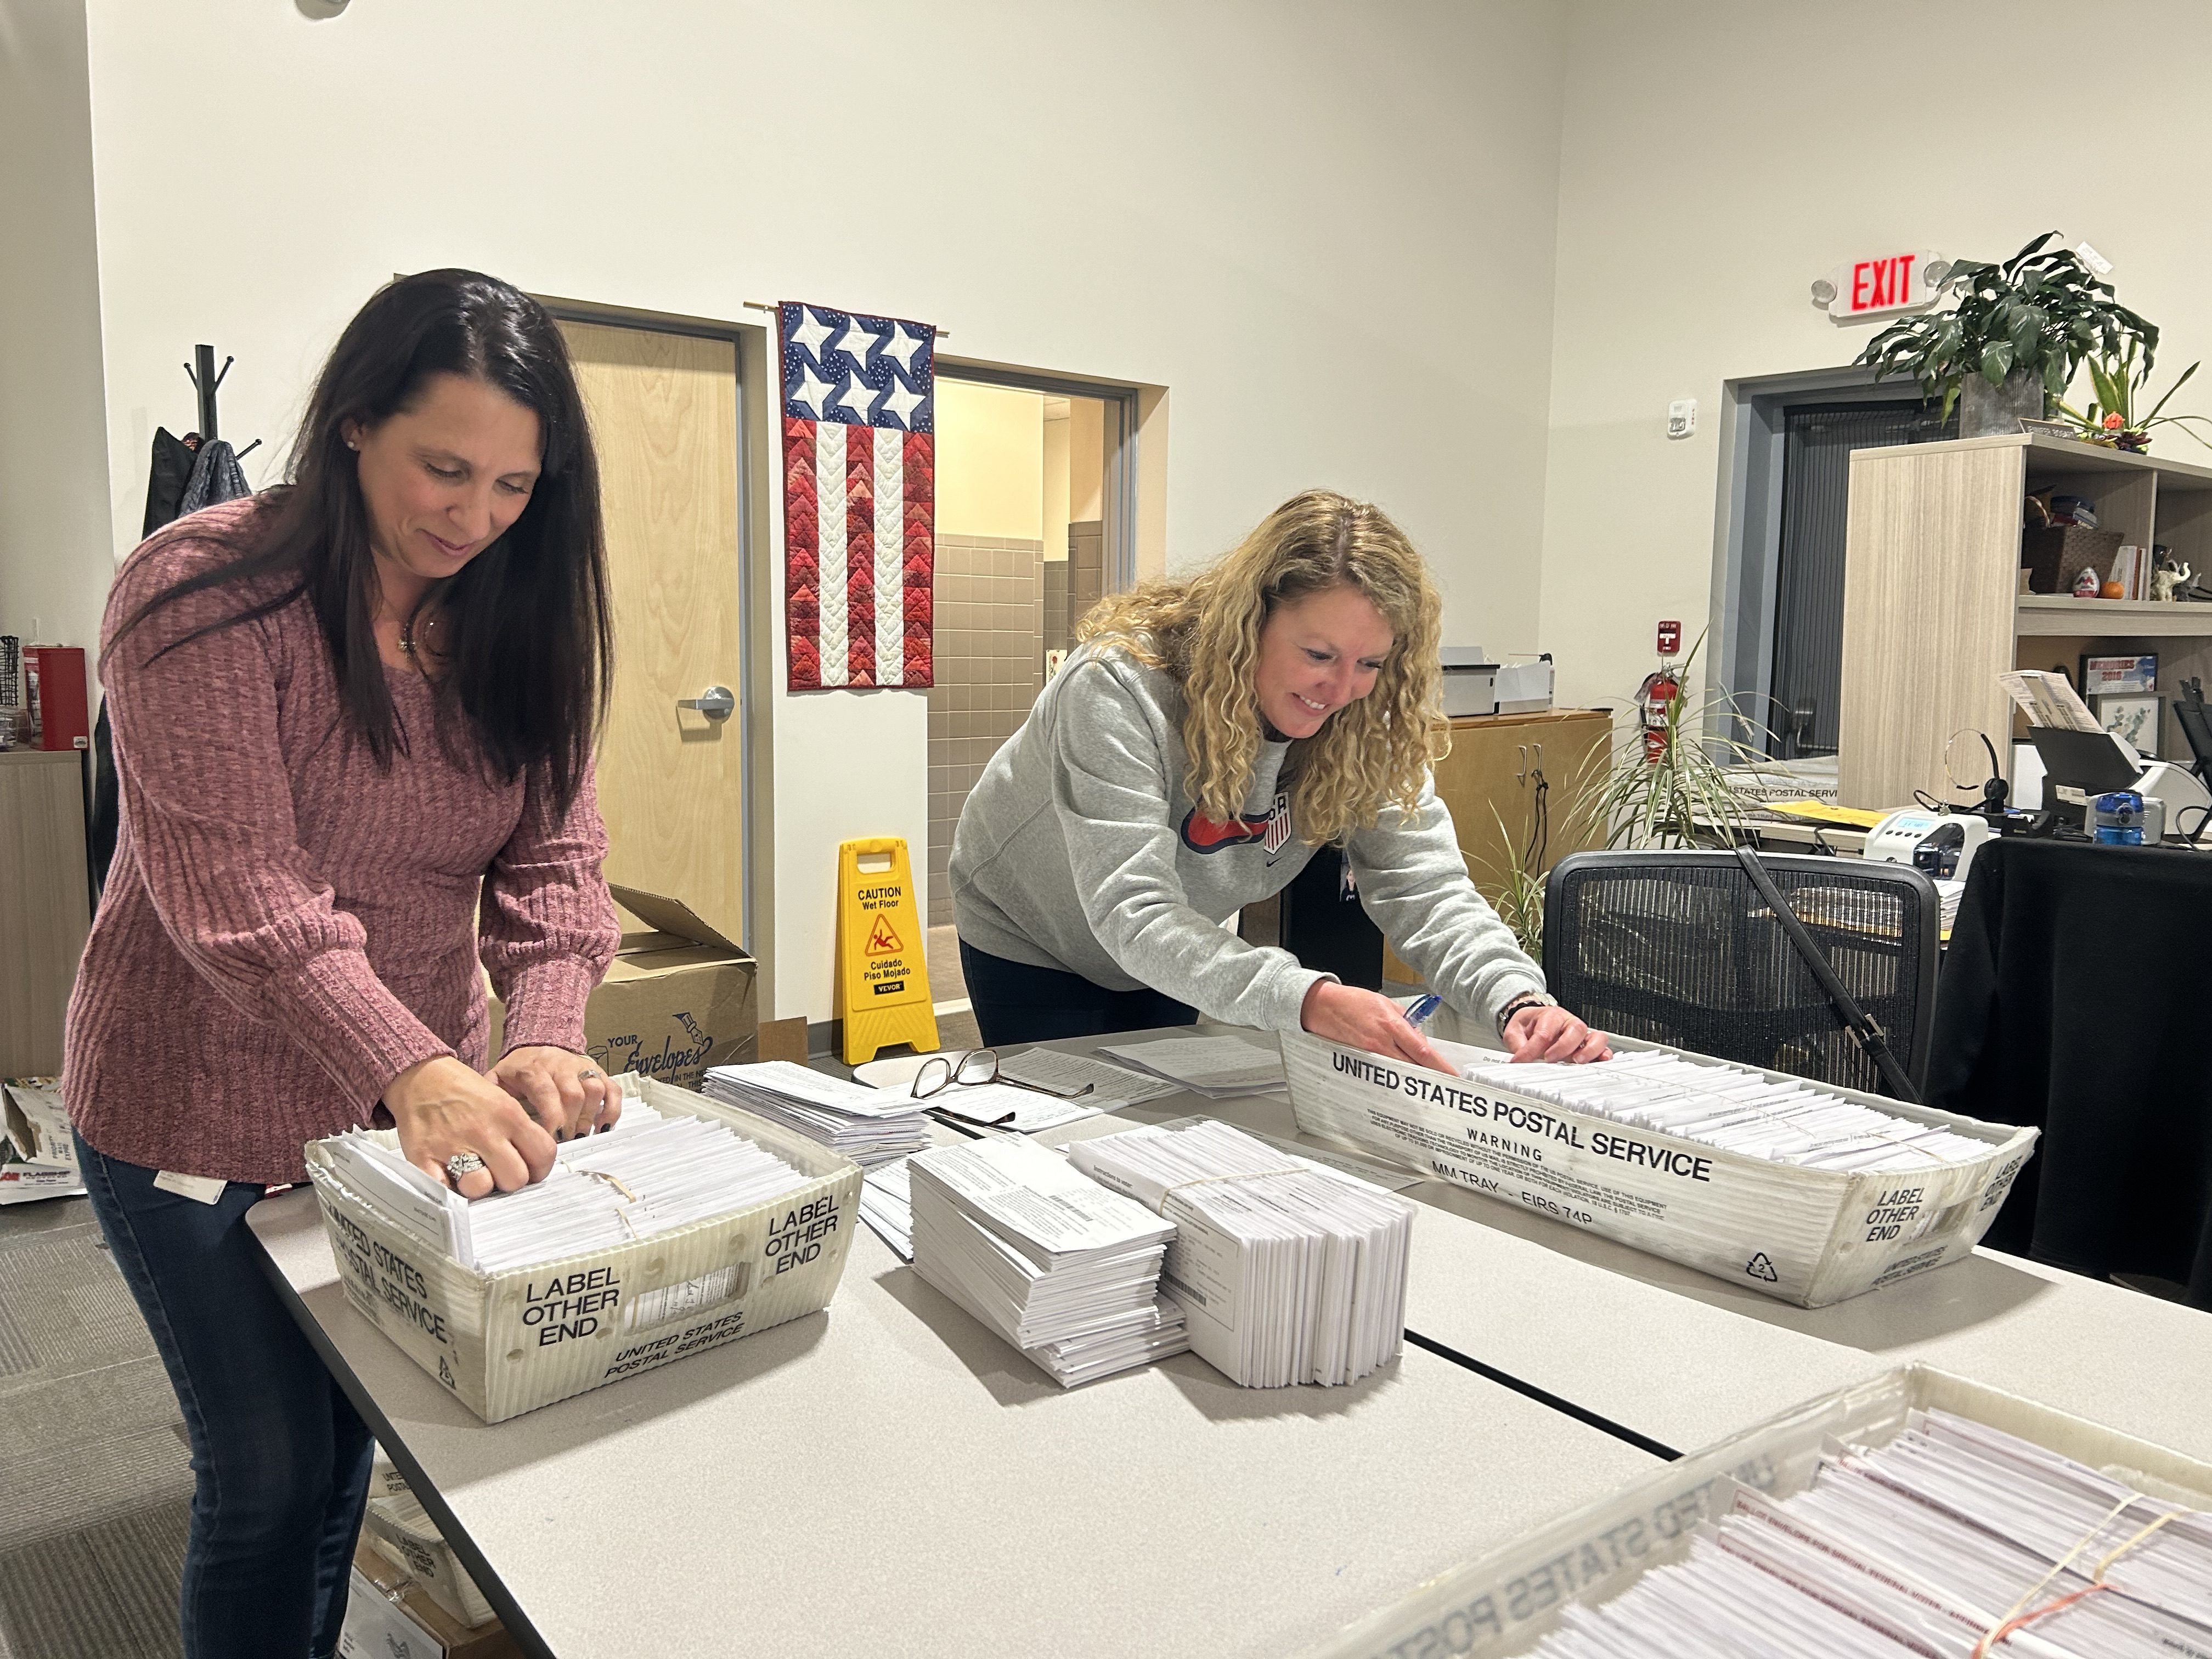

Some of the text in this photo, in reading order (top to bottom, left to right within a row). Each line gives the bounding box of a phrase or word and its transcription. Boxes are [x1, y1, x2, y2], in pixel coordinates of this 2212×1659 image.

[1852, 255, 1915, 311] EXIT
[858, 887, 901, 900] CAUTION
[862, 900, 899, 910] Wet Floor
[864, 967, 911, 980] Piso Mojado
[871, 959, 902, 970] Cuidado
[878, 984, 900, 992] VEVOR
[608, 1035, 637, 1048] YOUR
[684, 1071, 694, 1080] THE
[696, 1069, 705, 1077] NE
[1333, 1052, 1400, 1090] UNITED
[1404, 1076, 1488, 1119] STATES
[1493, 1103, 1584, 1150] POSTAL
[1591, 1133, 1713, 1182] SERVICE
[1466, 1128, 1542, 1161] WARNING
[1432, 1160, 1458, 1180] MM
[1459, 1170, 1498, 1193] TRAY
[1522, 1191, 1559, 1215] EIRS
[1563, 1206, 1592, 1224] 74P
[1877, 1187, 1925, 1206] LABEL
[769, 1196, 839, 1237] LABEL
[1866, 1206, 1920, 1224] OTHER
[765, 1215, 838, 1256] OTHER
[1865, 1224, 1901, 1242] END
[374, 1241, 427, 1299] STATES
[776, 1243, 821, 1275] END
[527, 1267, 620, 1303] LABEL
[381, 1277, 448, 1344] SERVICE
[522, 1289, 619, 1327] OTHER
[539, 1317, 598, 1347] END
[616, 1312, 743, 1362] UNITED STATES
[605, 1323, 745, 1379] POSTAL SERVICE
